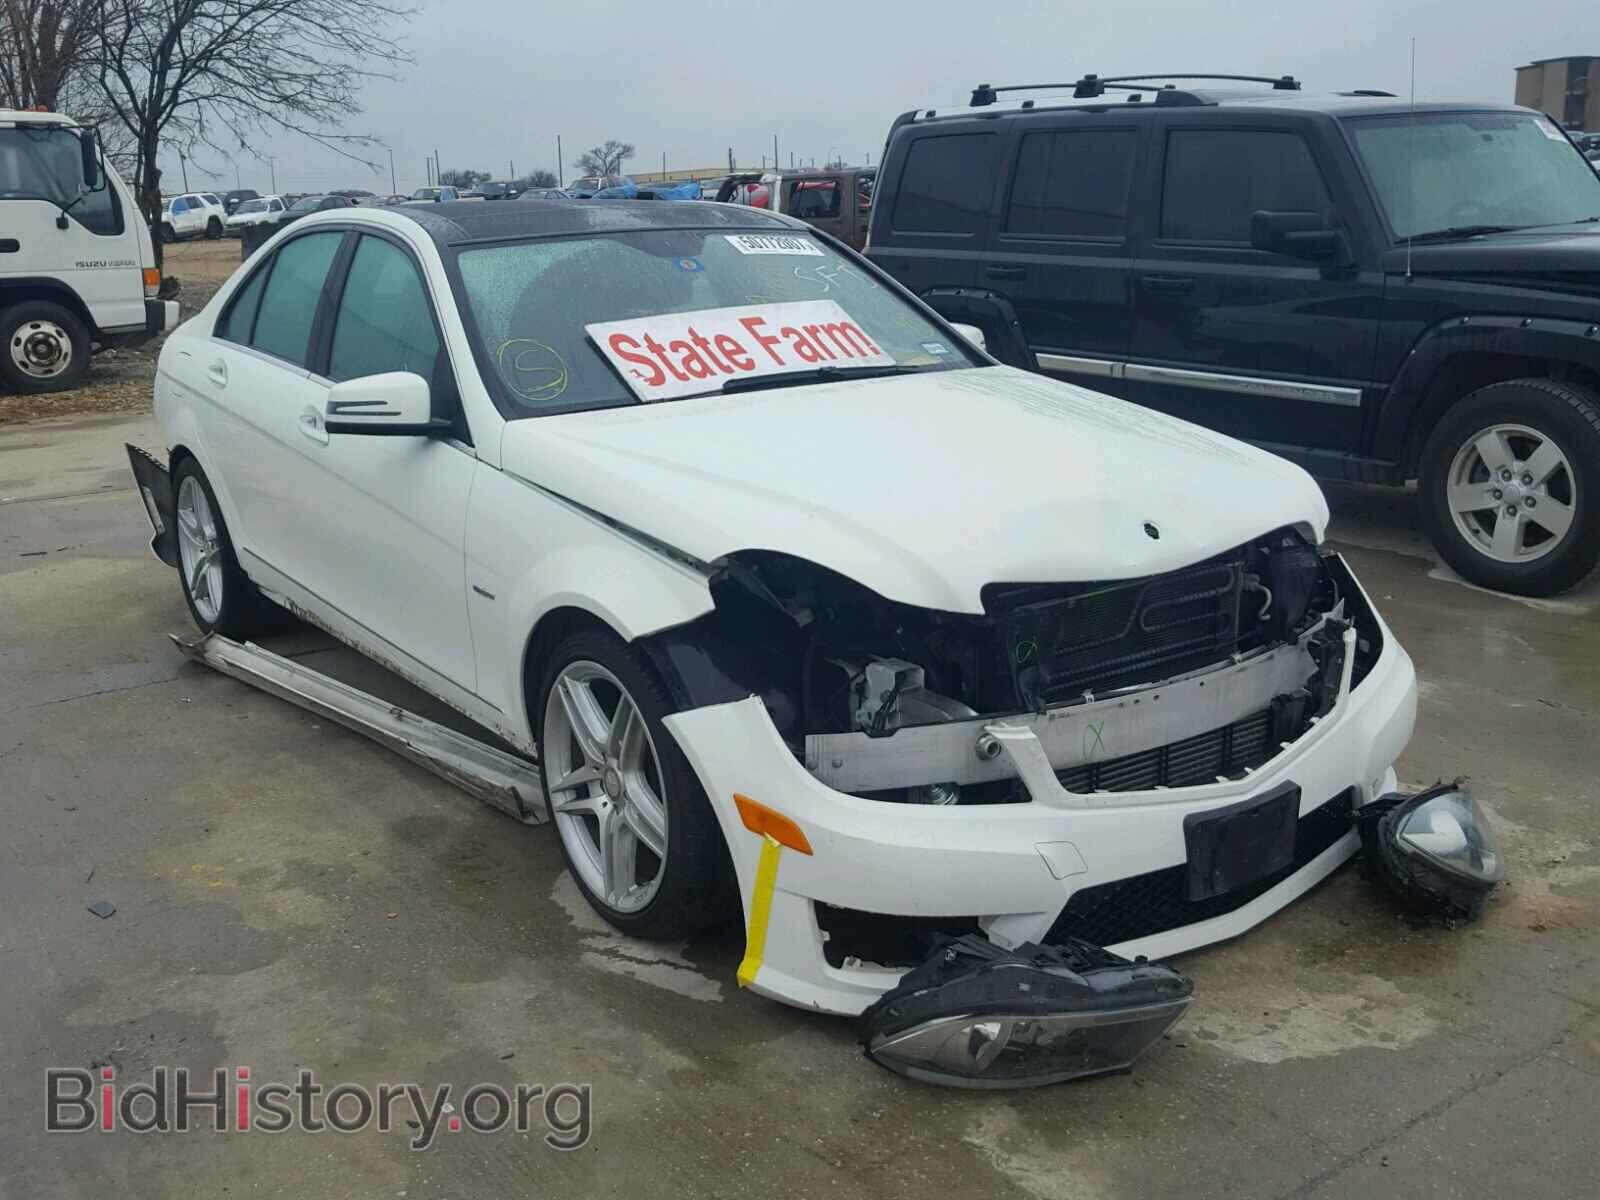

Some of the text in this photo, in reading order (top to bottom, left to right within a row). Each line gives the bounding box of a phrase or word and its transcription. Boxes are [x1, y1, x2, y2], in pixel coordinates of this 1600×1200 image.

[75, 260, 107, 268] ISUZU
[608, 316, 881, 387] State Farm
